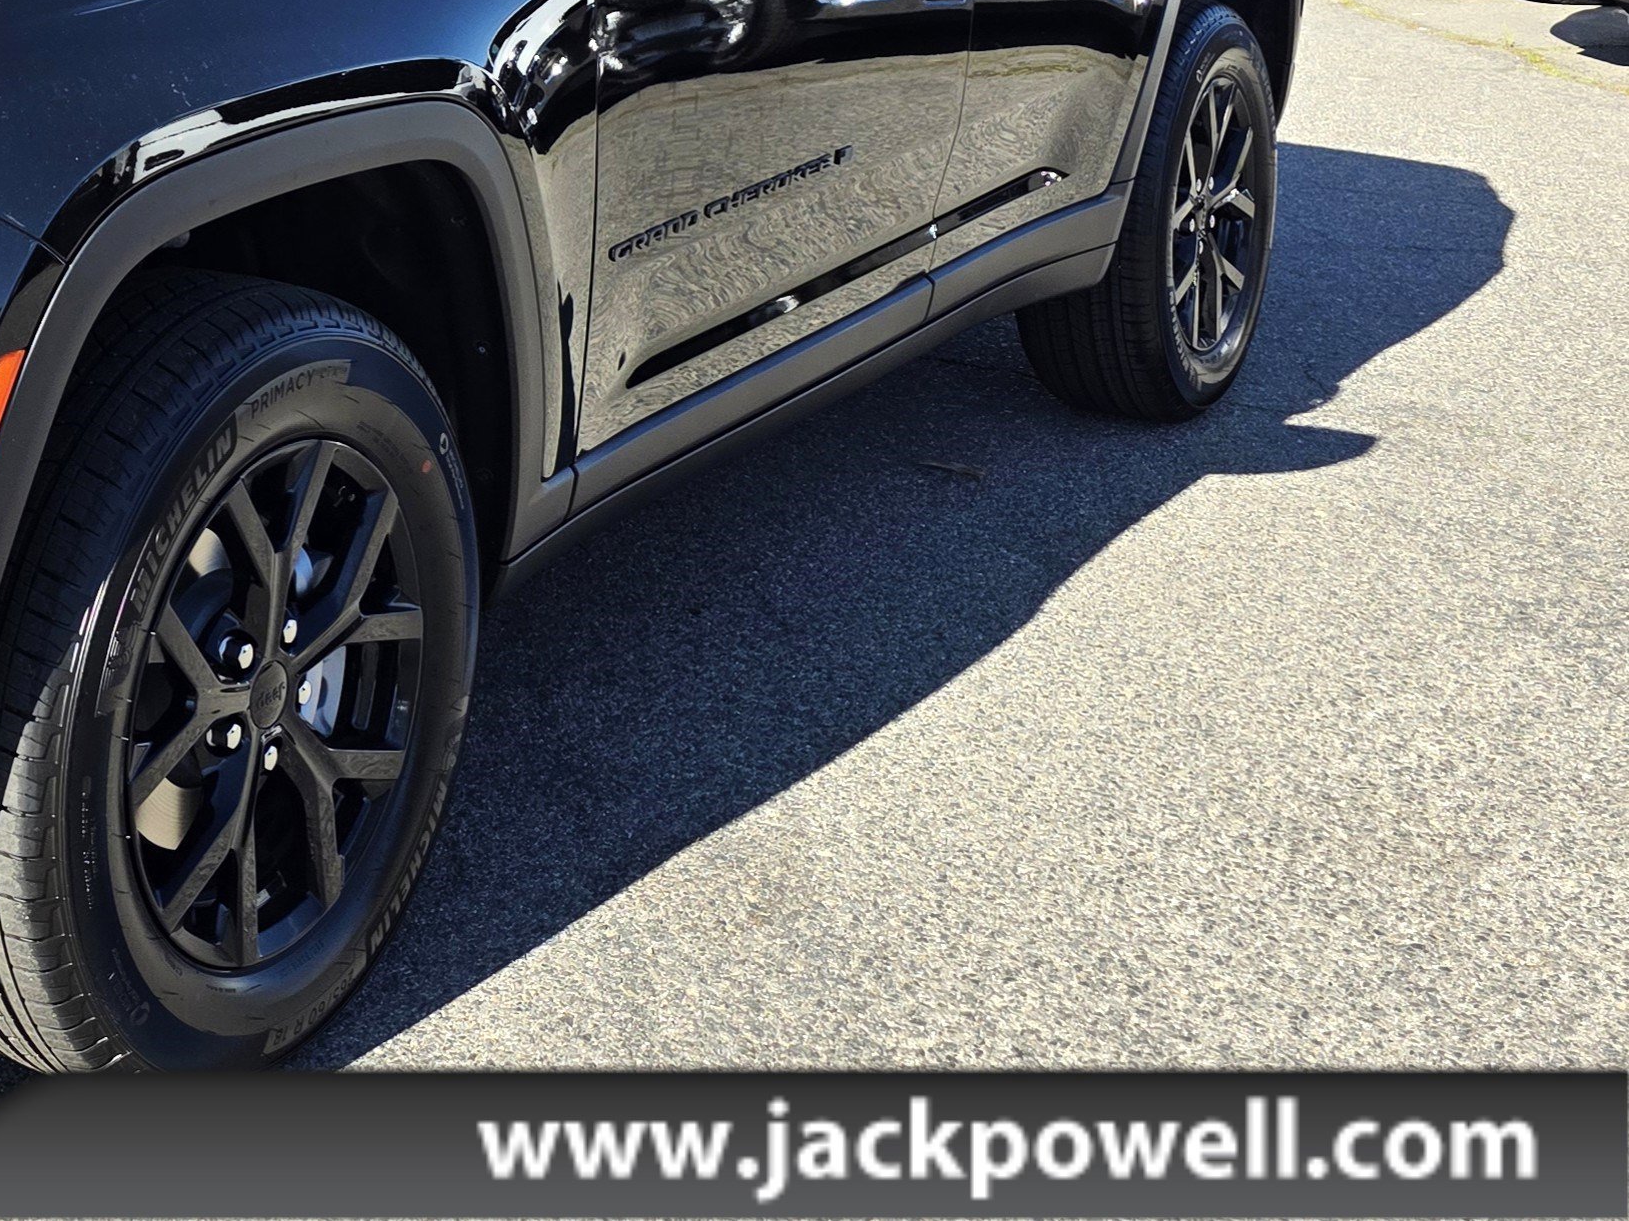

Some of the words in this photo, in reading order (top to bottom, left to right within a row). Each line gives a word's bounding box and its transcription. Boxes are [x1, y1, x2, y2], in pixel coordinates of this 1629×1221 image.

[608, 200, 698, 261] GRAND
[703, 153, 833, 218] CHEROKEE
[249, 369, 316, 420] PRIMACY
[130, 429, 234, 614] MICHELIN
[369, 781, 448, 956] MICHELIN
